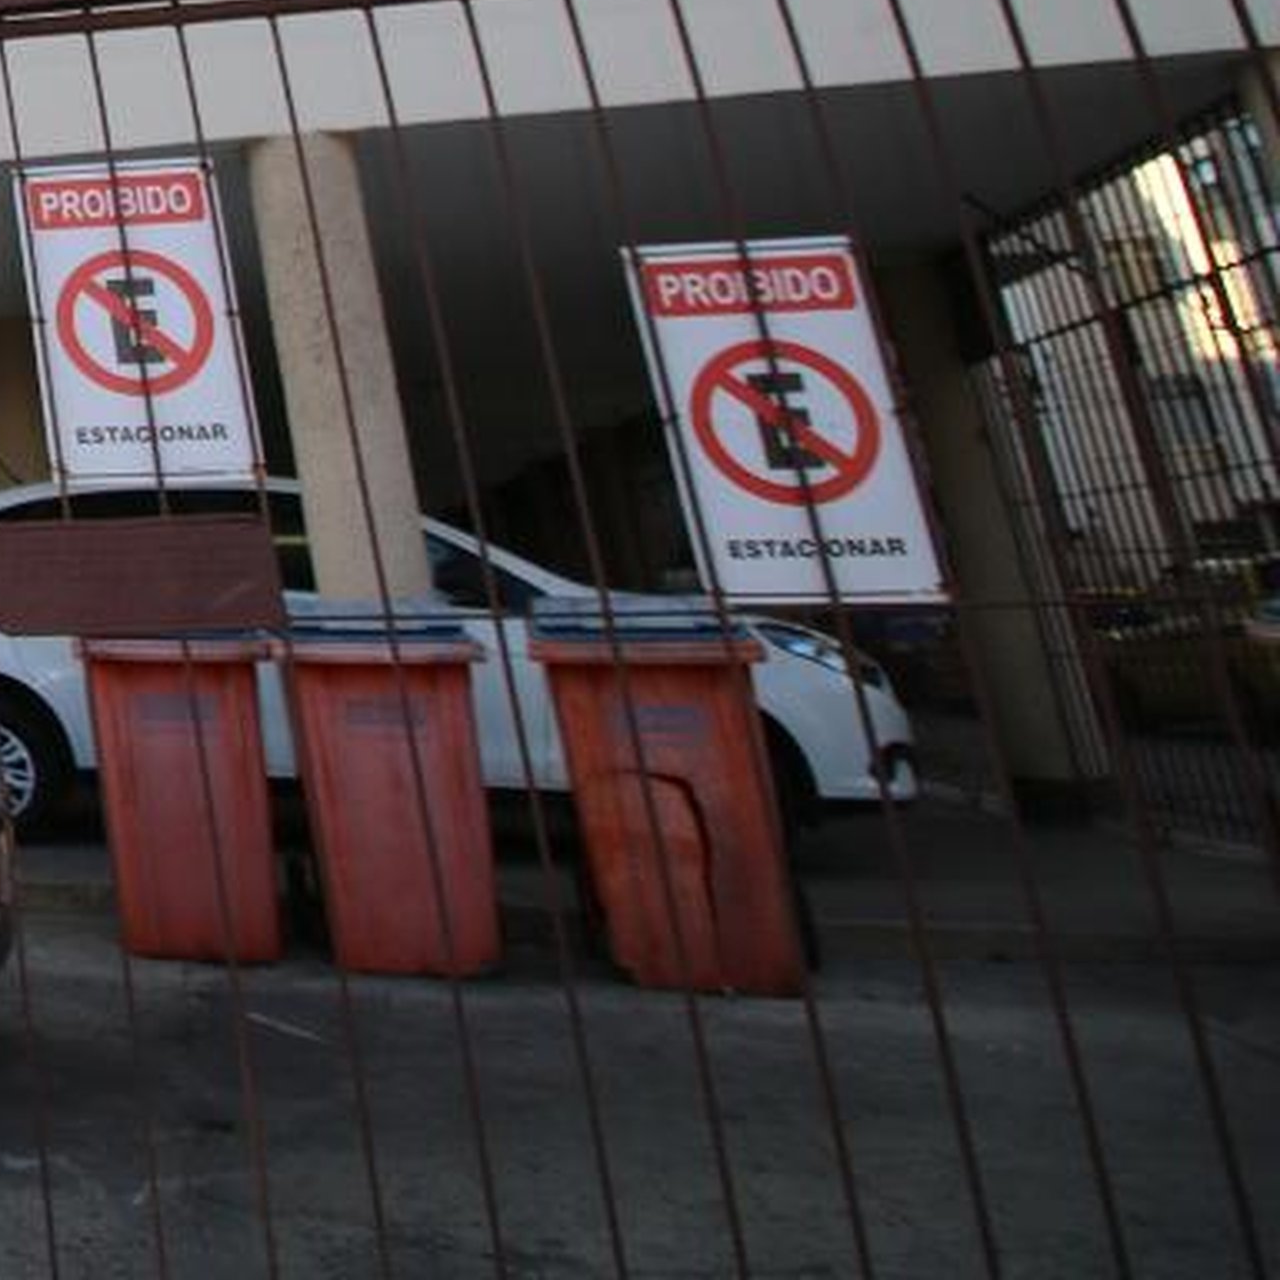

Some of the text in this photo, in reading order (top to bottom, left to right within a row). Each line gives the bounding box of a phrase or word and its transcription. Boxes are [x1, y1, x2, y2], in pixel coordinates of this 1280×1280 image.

[40, 183, 191, 221] PROIBIDO
[657, 266, 840, 308] PROIBIDO
[76, 423, 228, 445] ESTACONAR
[727, 537, 907, 560] ESTACONAR
